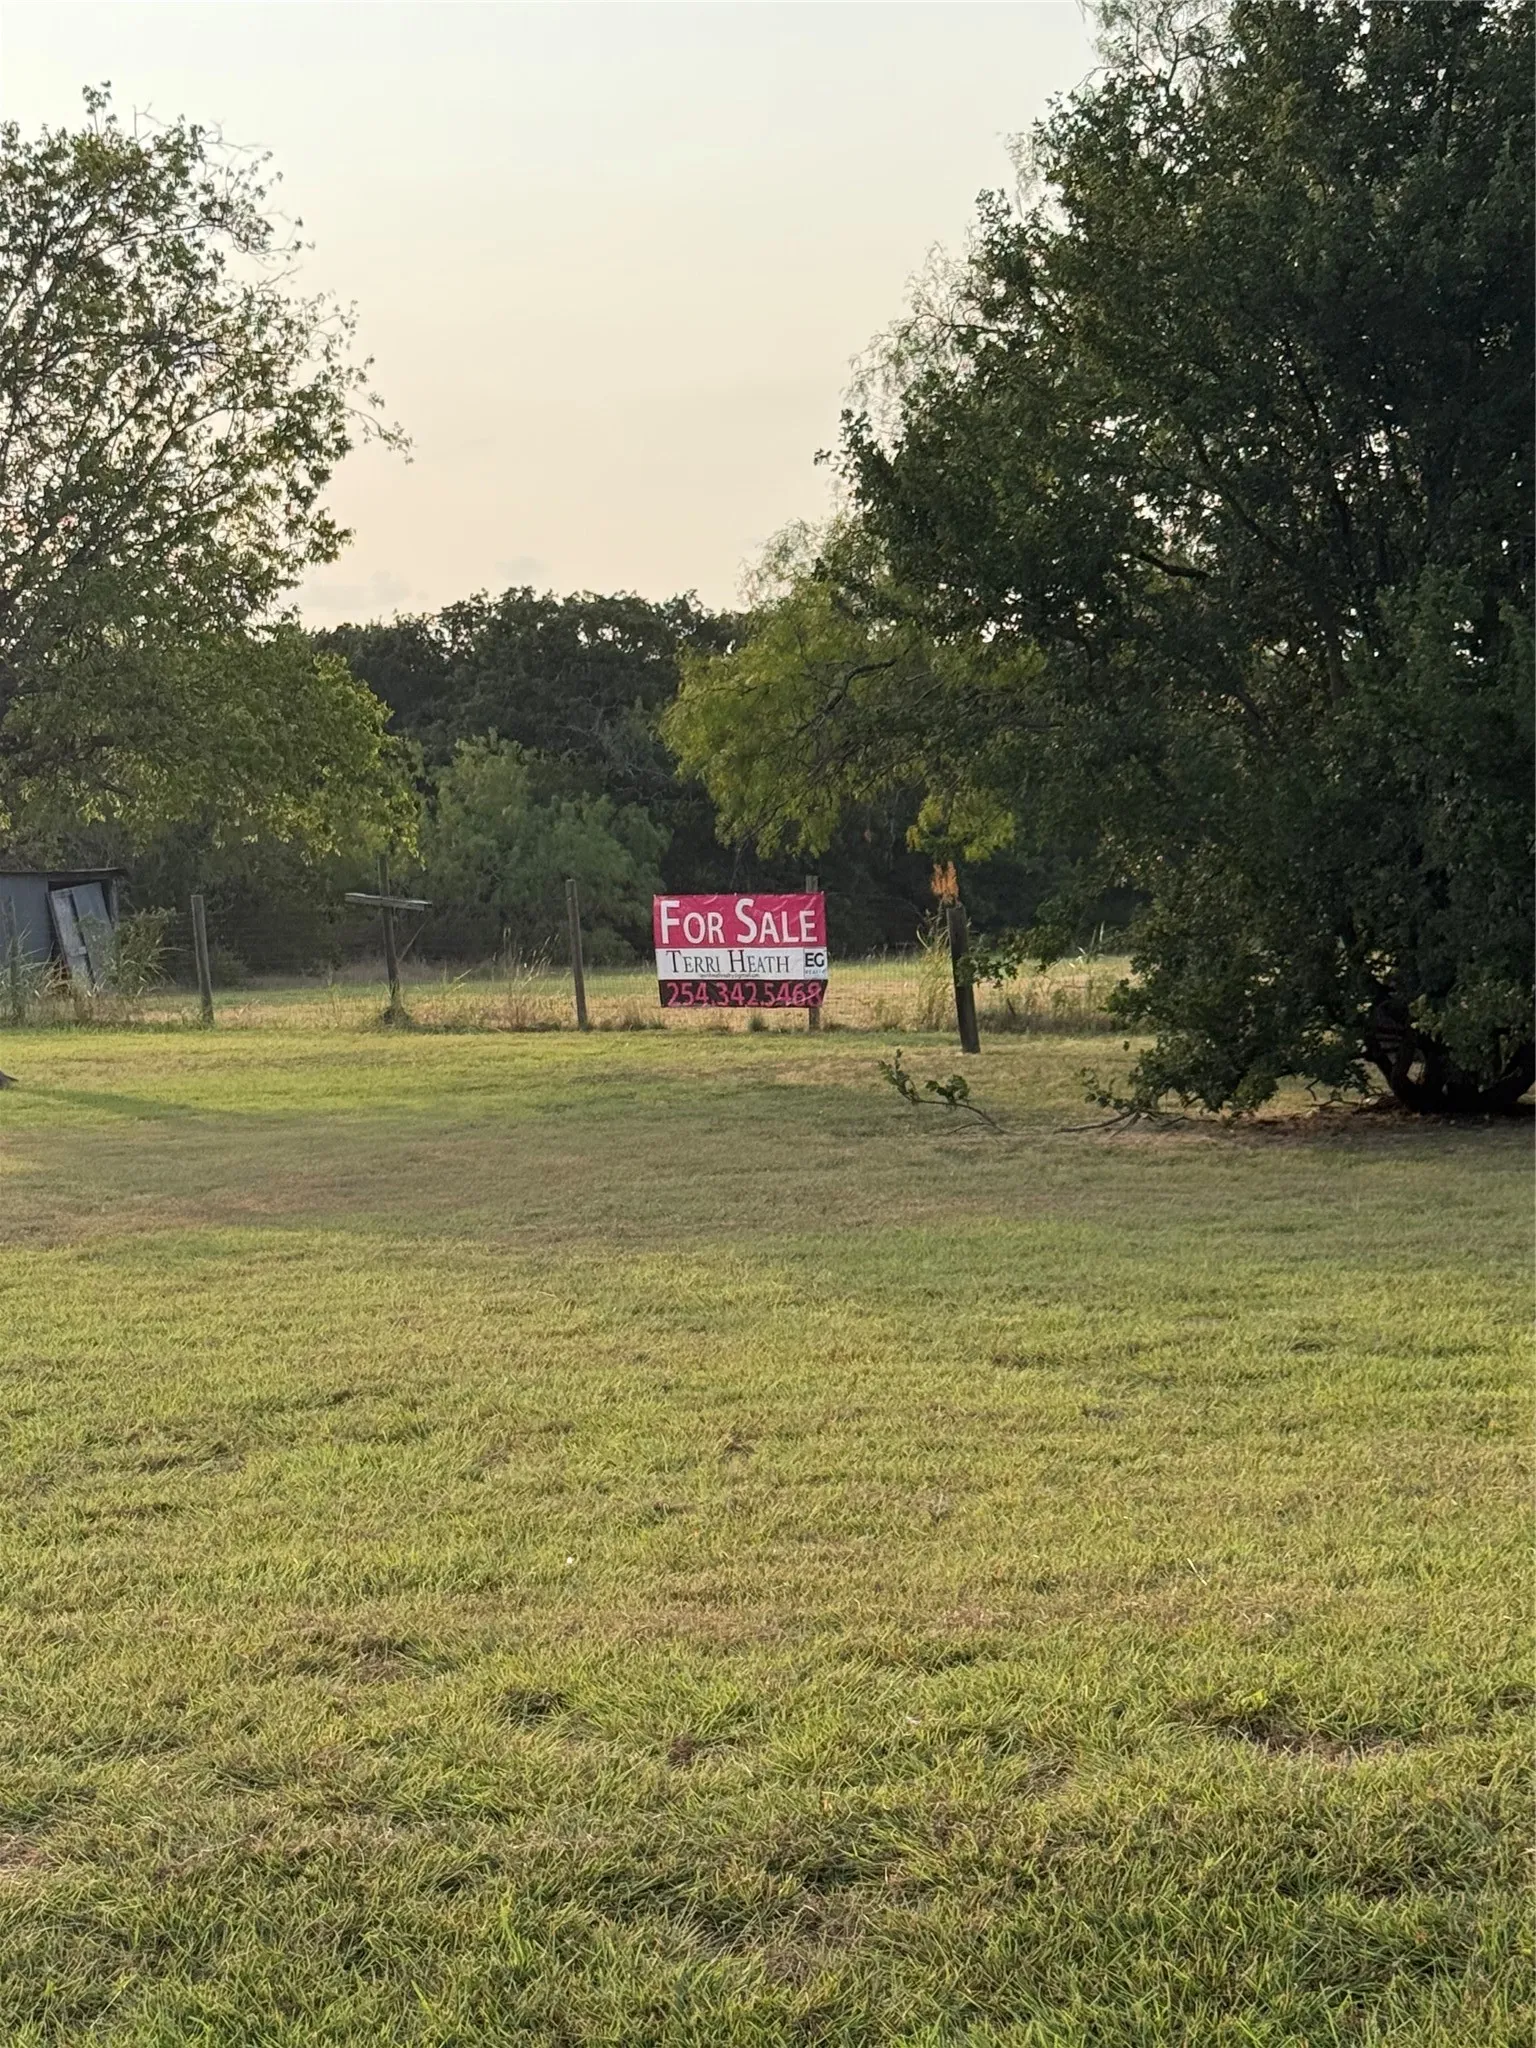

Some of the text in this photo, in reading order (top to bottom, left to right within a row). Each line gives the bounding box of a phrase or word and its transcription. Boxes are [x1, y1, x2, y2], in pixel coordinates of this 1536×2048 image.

[660, 898, 818, 944] FOR SALE
[666, 949, 790, 973] TERRI HEATH
[804, 952, 825, 967] EG
[667, 982, 822, 1007] 254.342.5468
